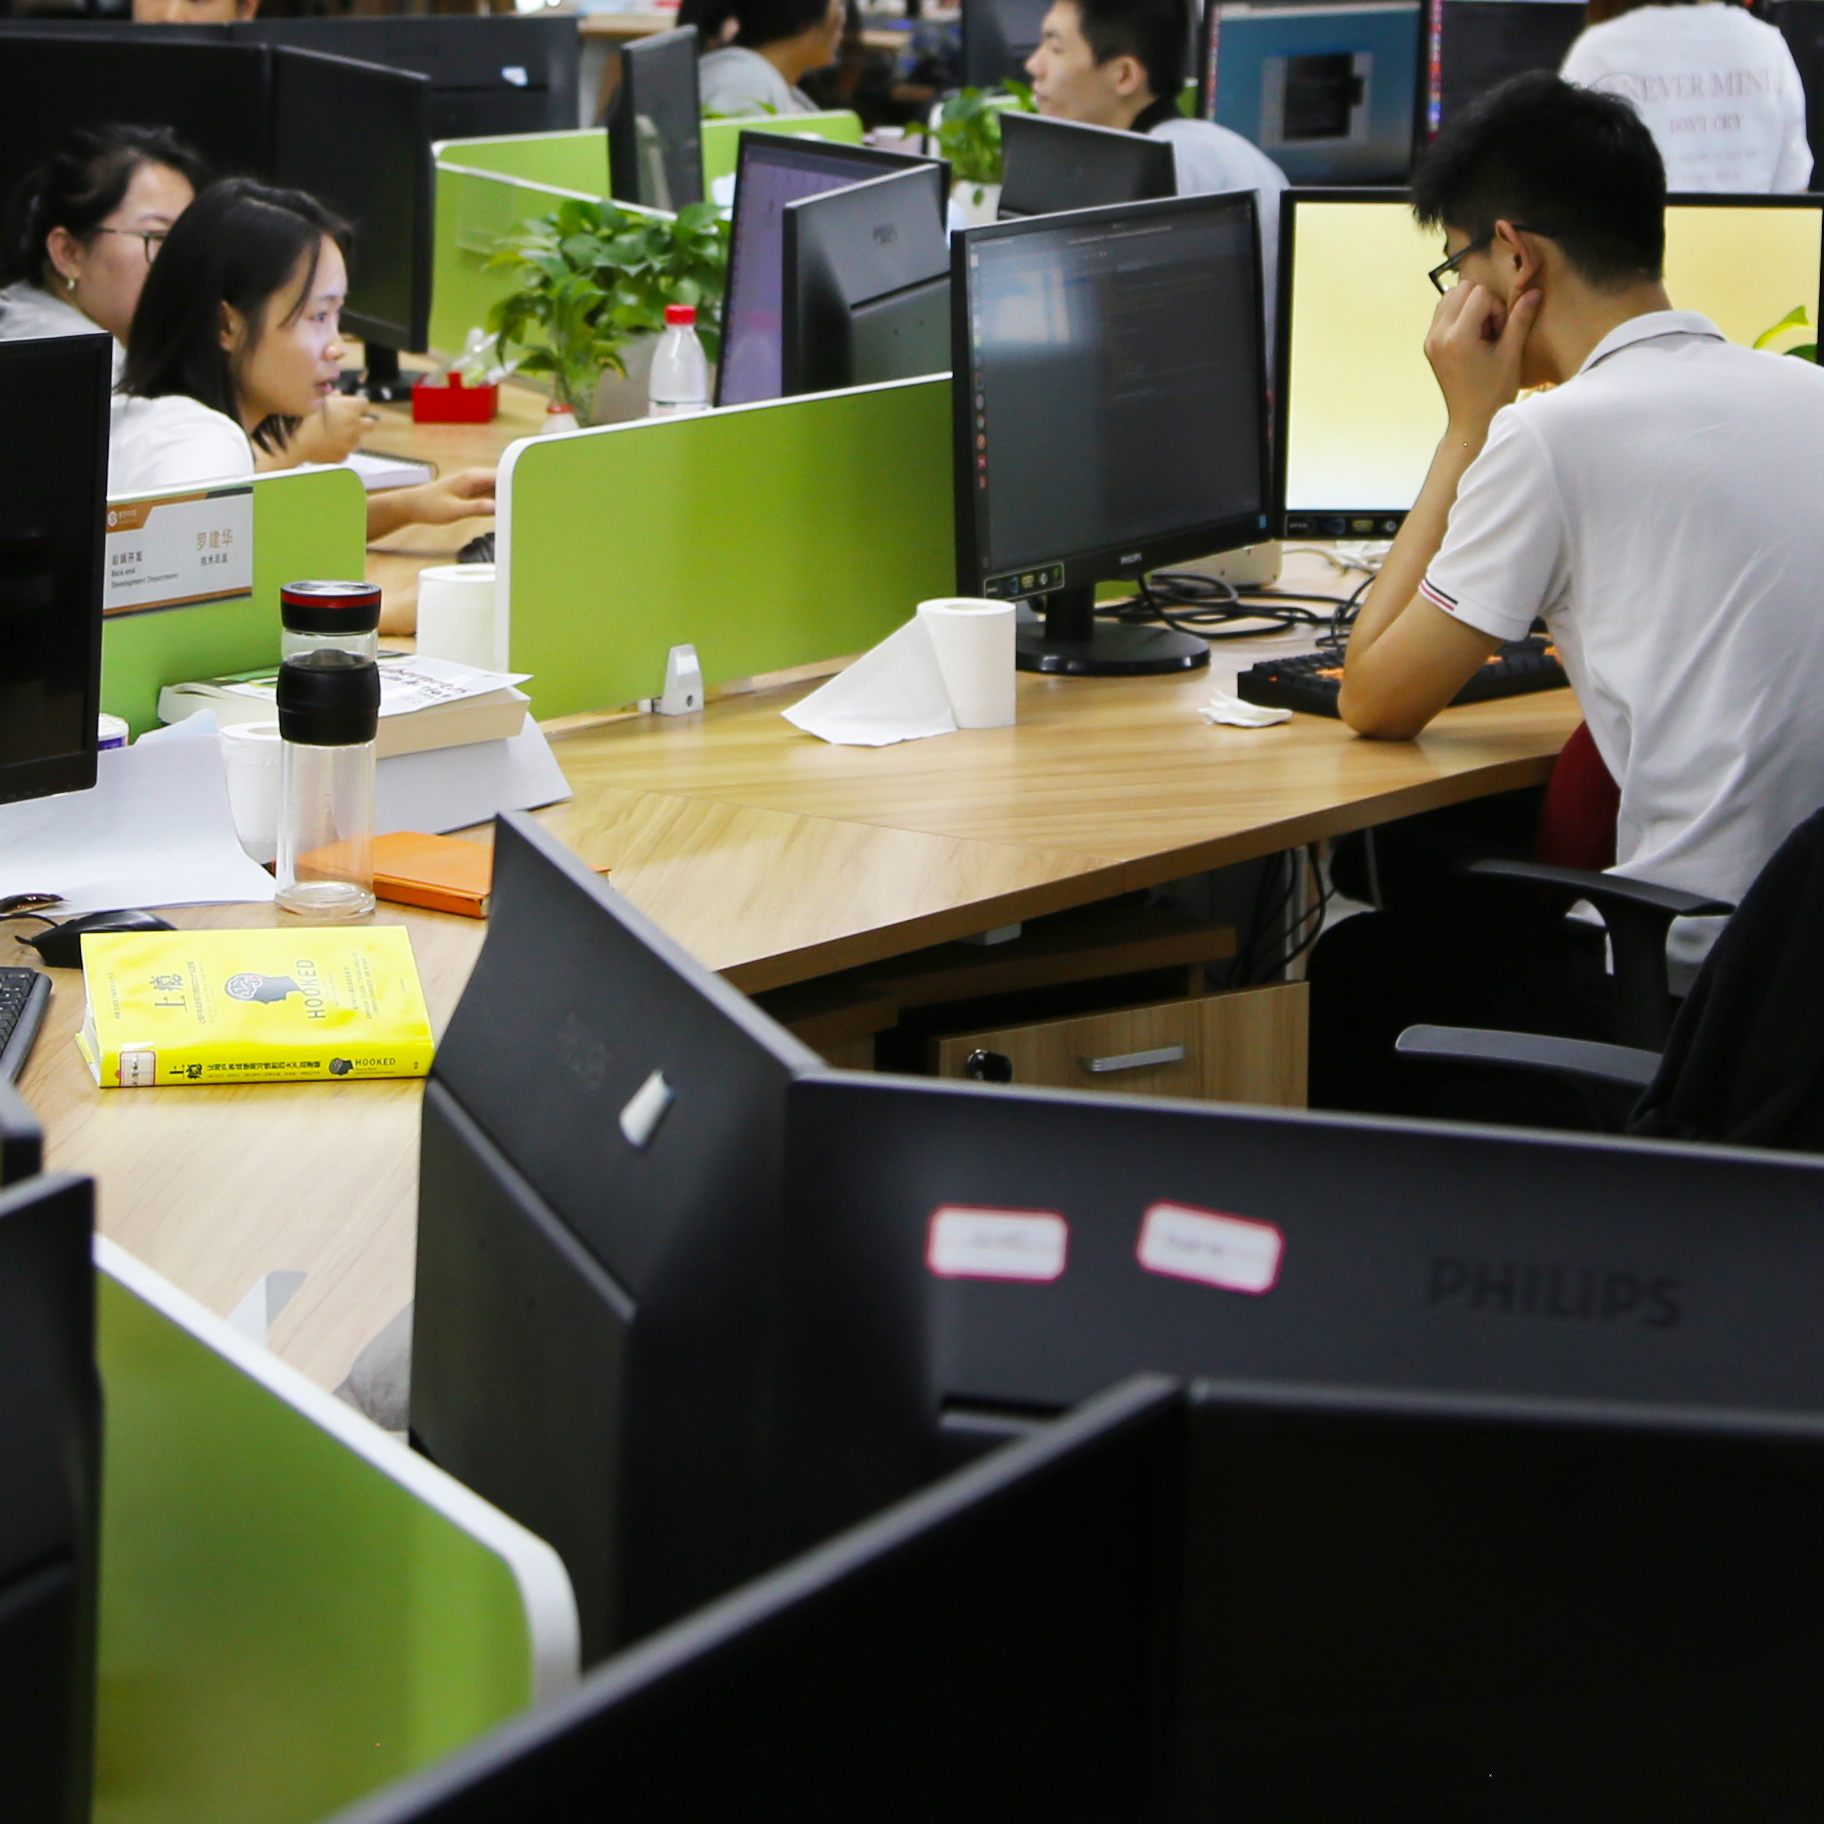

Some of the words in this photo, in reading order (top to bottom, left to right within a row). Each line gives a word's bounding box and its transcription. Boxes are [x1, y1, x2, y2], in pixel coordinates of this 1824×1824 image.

[1627, 73, 1704, 103] NEVER
[196, 529, 233, 552] 罗建华
[149, 972, 188, 1014] 上瘾
[295, 959, 327, 1020] HOOKED
[169, 1063, 203, 1080] 上瘾
[356, 1057, 396, 1066] HOOKED
[1428, 1253, 1684, 1330] PHILIPS
